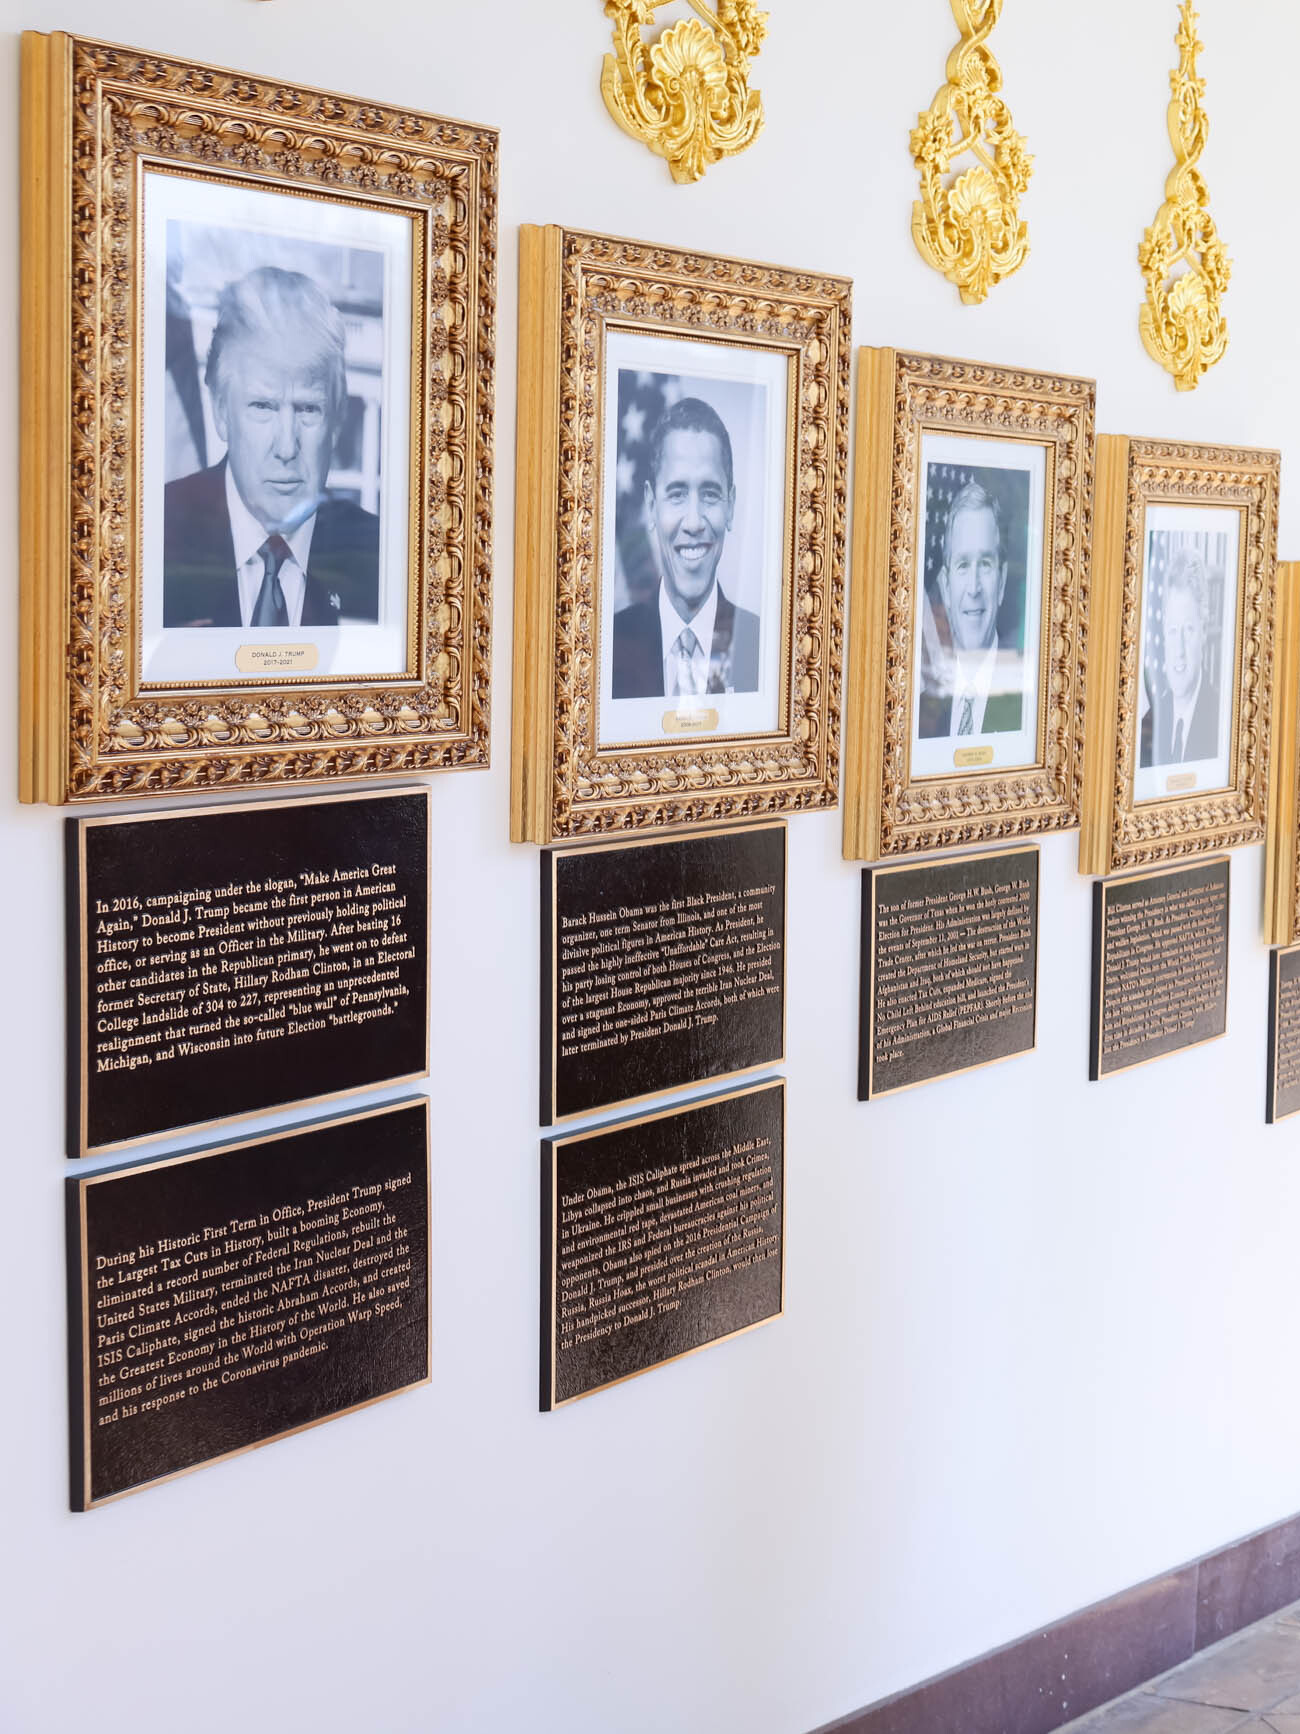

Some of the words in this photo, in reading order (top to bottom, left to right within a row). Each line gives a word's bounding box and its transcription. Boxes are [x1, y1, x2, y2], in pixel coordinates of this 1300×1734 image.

[96, 900, 109, 914] In
[112, 896, 143, 911] 2016,
[146, 889, 212, 908] campaigning
[214, 883, 243, 898] under
[245, 880, 261, 894] the
[264, 878, 297, 893] slogan,
[332, 867, 369, 882] America
[371, 863, 396, 876] Great
[141, 909, 181, 927] Donald
[182, 908, 192, 924] J.
[194, 906, 230, 919] Trump
[232, 901, 268, 914] became
[271, 896, 286, 908] the
[289, 893, 308, 906] first
[310, 891, 340, 906] person
[343, 887, 352, 898] in
[354, 882, 396, 896] American
[561, 914, 587, 928] Barack
[588, 910, 617, 924] Hussein
[618, 906, 644, 918] Obama
[644, 905, 657, 914] was
[659, 901, 670, 912] the
[671, 898, 685, 910] first
[686, 894, 705, 907] Black
[742, 884, 775, 897] community
[96, 939, 139, 953] History
[142, 937, 153, 947] to
[156, 930, 195, 944] become
[197, 921, 245, 938] President
[247, 916, 285, 930] without
[287, 907, 334, 928] previously
[336, 903, 370, 917] holding
[372, 895, 406, 915] political
[97, 958, 131, 973] office,
[135, 957, 147, 967] or
[150, 950, 187, 965] serving
[190, 949, 200, 959] as
[203, 946, 215, 956] an
[218, 939, 254, 954] Officer
[256, 936, 266, 948] in
[269, 933, 284, 946] the
[287, 929, 327, 943] Military.
[330, 922, 354, 936] After
[356, 918, 389, 932] beating
[391, 914, 401, 926] 16
[561, 930, 598, 946] organizer,
[599, 928, 613, 937] one
[614, 925, 631, 935] term
[632, 920, 658, 932] Senator
[659, 916, 676, 927] from
[676, 910, 702, 924] Illinois,
[703, 907, 715, 919] and
[716, 908, 728, 917] one
[728, 903, 737, 914] of
[737, 902, 747, 913] the
[748, 901, 763, 911] most
[97, 978, 127, 993] other
[129, 970, 184, 988] candidates
[187, 966, 198, 978] in
[201, 962, 218, 976] the
[220, 955, 274, 974] Republican
[277, 949, 316, 967] primary,
[318, 944, 330, 956] he
[331, 941, 354, 953] went
[356, 940, 367, 950] on
[370, 938, 379, 948] to
[381, 931, 407, 945] defeat
[96, 1054, 152, 1072] Michigan,
[155, 1045, 175, 1061] and
[177, 1036, 230, 1056] Wisconsin
[233, 1034, 253, 1046] into
[256, 1027, 285, 1041] future
[287, 1018, 326, 1034] Election
[561, 1192, 585, 1207] Under
[586, 1186, 614, 1199] Obama,
[615, 1179, 627, 1191] the
[628, 1172, 644, 1187] ISIS
[645, 1166, 678, 1182] Caliphate
[679, 1155, 700, 1174] spread
[701, 1153, 720, 1165] across
[721, 1147, 732, 1159] the
[731, 1140, 755, 1157] Middle
[96, 1252, 136, 1270] During
[138, 1244, 154, 1258] his
[157, 1233, 200, 1253] Historic
[203, 1226, 227, 1241] First
[229, 1219, 257, 1233] Term
[259, 1214, 270, 1225] in
[272, 1205, 304, 1221] Office,
[307, 1192, 350, 1212] President
[351, 1184, 382, 1199] Trump
[384, 1172, 412, 1191] signed
[96, 1275, 114, 1289] the
[118, 1264, 158, 1283] Largest
[160, 1257, 181, 1271] Tax
[184, 1251, 208, 1264] Cuts
[211, 1246, 221, 1258] in
[224, 1236, 264, 1254] History,
[267, 1225, 289, 1241] built
[292, 1226, 298, 1234] a
[299, 1214, 340, 1232] booming
[342, 1201, 385, 1220] Economy,
[96, 1306, 135, 1328] United
[138, 1300, 170, 1316] States
[173, 1286, 218, 1306] Military,
[221, 1265, 273, 1291] terminated
[276, 1262, 291, 1275] the
[294, 1257, 313, 1270] Iran
[316, 1246, 350, 1263] Nuclear
[352, 1235, 374, 1252] Deal
[376, 1229, 392, 1245] and
[394, 1227, 408, 1239] the
[97, 1281, 154, 1308] eliminated
[157, 1283, 163, 1292] a
[166, 1268, 199, 1289] record
[202, 1260, 239, 1279] number
[242, 1252, 254, 1267] of
[254, 1242, 290, 1263] Federal
[293, 1230, 349, 1252] Regulations,
[351, 1217, 380, 1235] rebuilt
[382, 1213, 396, 1225] the
[560, 1336, 573, 1350] the
[574, 1326, 613, 1344] Presidency
[614, 1321, 622, 1330] to
[623, 1308, 648, 1327] Donald
[648, 1306, 656, 1319] J.
[657, 1299, 682, 1314] Trump.
